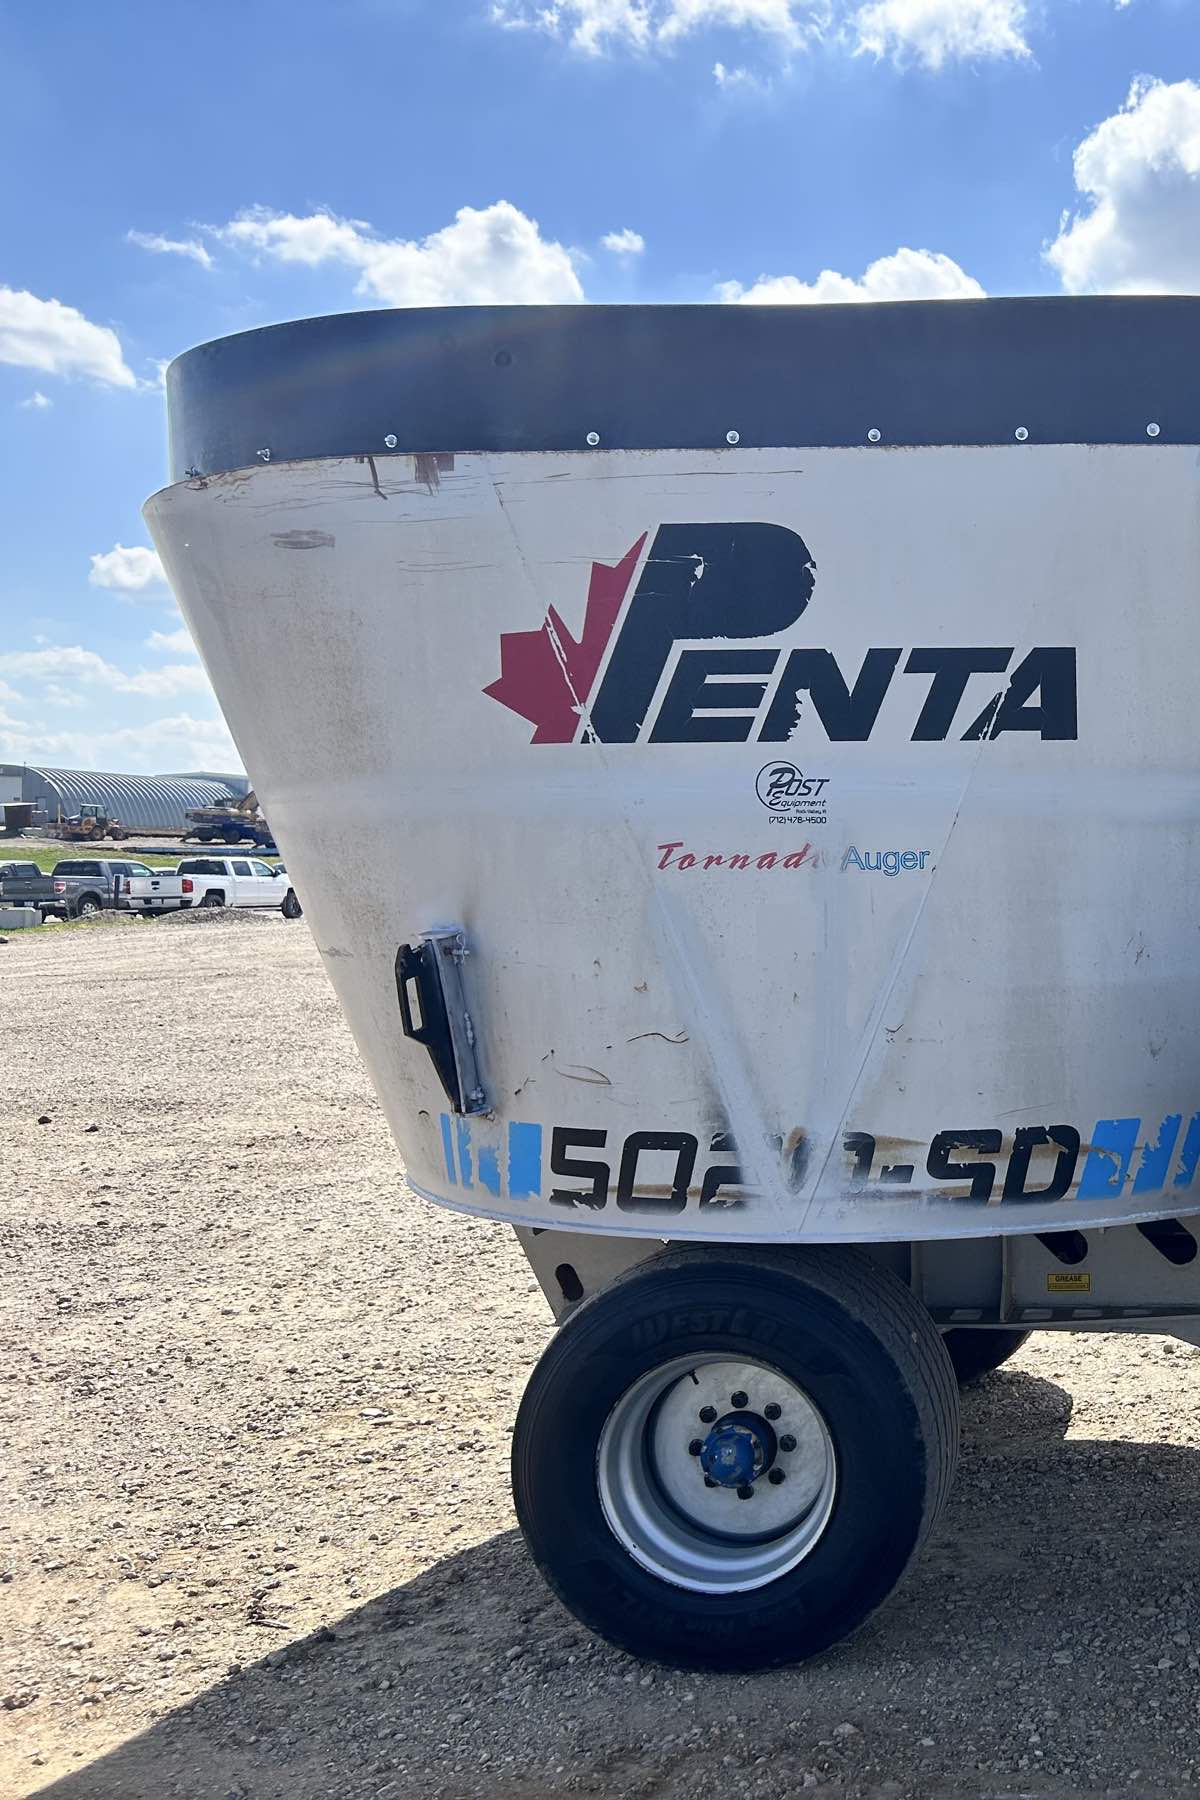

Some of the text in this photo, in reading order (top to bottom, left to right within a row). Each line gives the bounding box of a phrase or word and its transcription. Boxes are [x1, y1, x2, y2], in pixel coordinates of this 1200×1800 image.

[579, 521, 1078, 744] PENTA
[766, 767, 830, 797] POST
[768, 790, 827, 808] Equipment
[656, 841, 826, 871] Tornad
[843, 846, 931, 877] Auger
